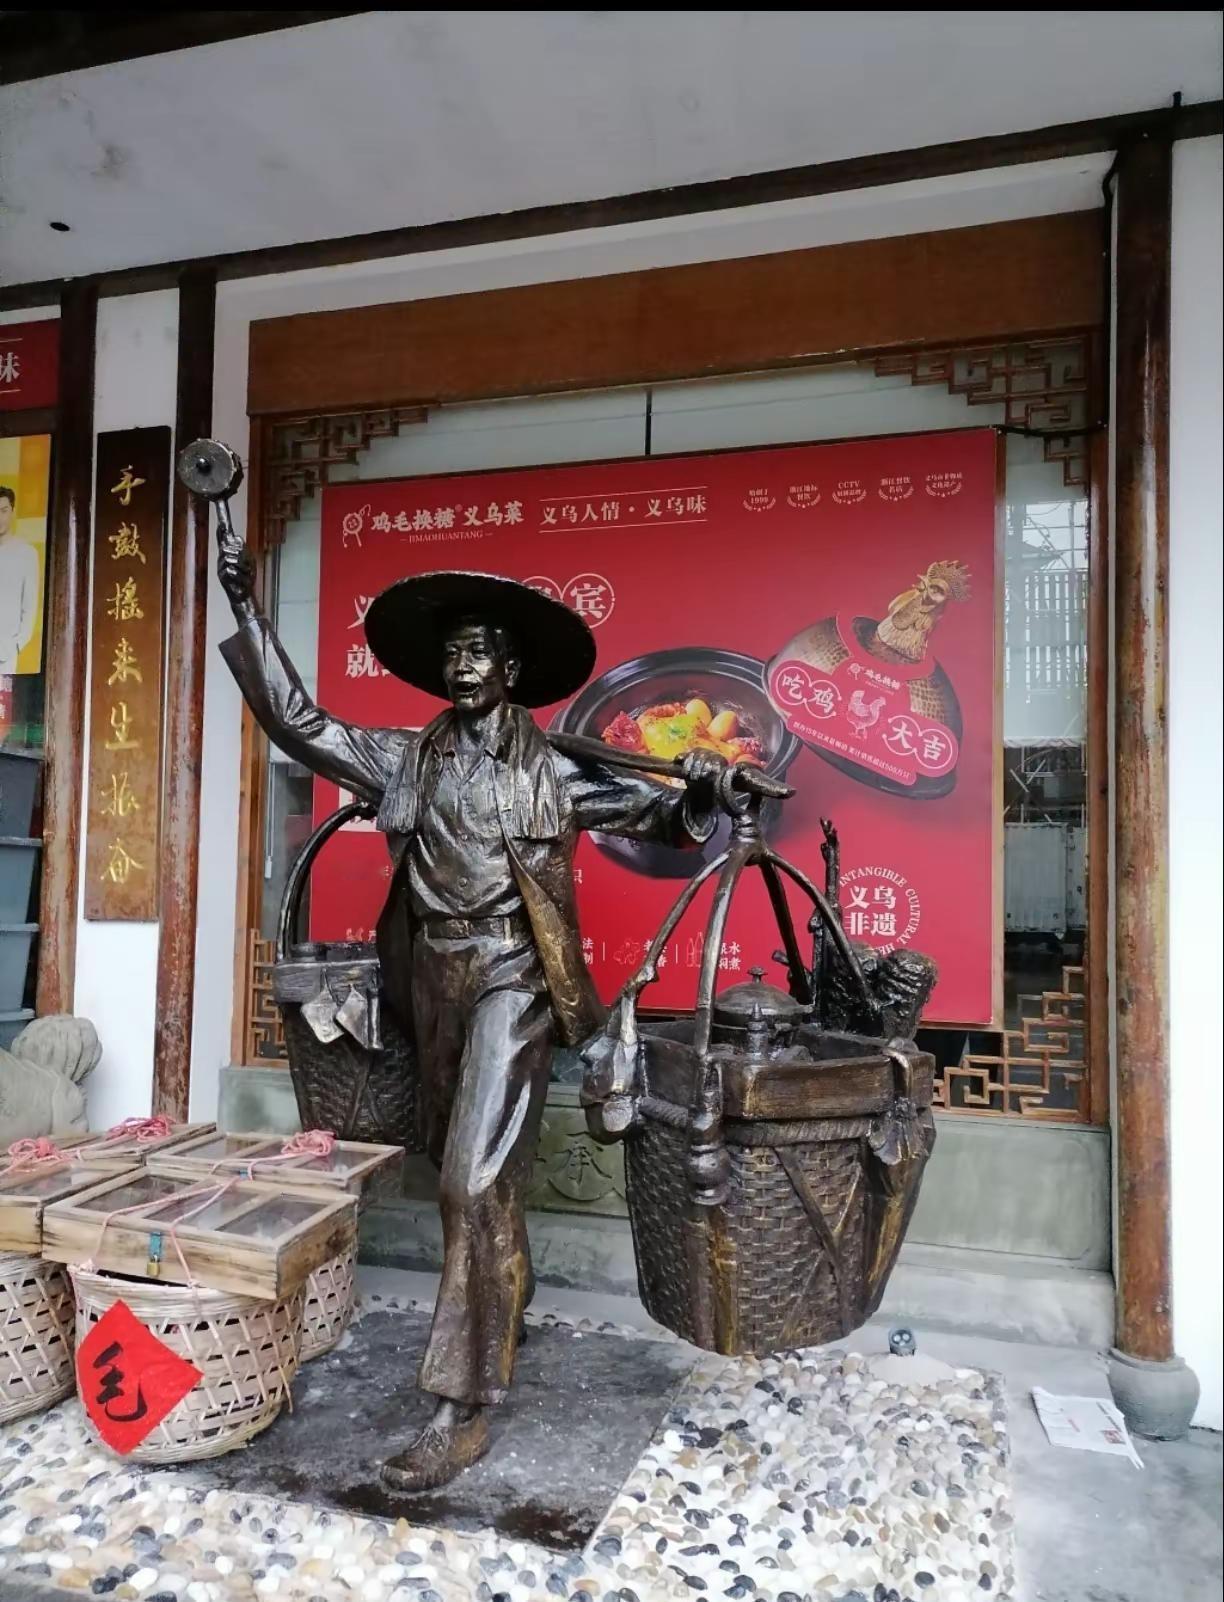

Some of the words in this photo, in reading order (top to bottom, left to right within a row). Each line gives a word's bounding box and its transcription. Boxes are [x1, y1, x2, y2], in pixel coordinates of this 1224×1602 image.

[837, 480, 860, 490] CCTV
[371, 507, 456, 533] 鸡毛换糖
[463, 500, 525, 526] 义乌菜
[344, 643, 391, 680] 就
[782, 673, 834, 713] 吃鸡
[889, 721, 946, 761] 大吉
[839, 866, 908, 888] INTANGIBLE
[896, 888, 921, 945] CULTURAL
[844, 885, 897, 910] 义乌
[844, 911, 898, 937] 非遗
[93, 1341, 148, 1422] 毛
